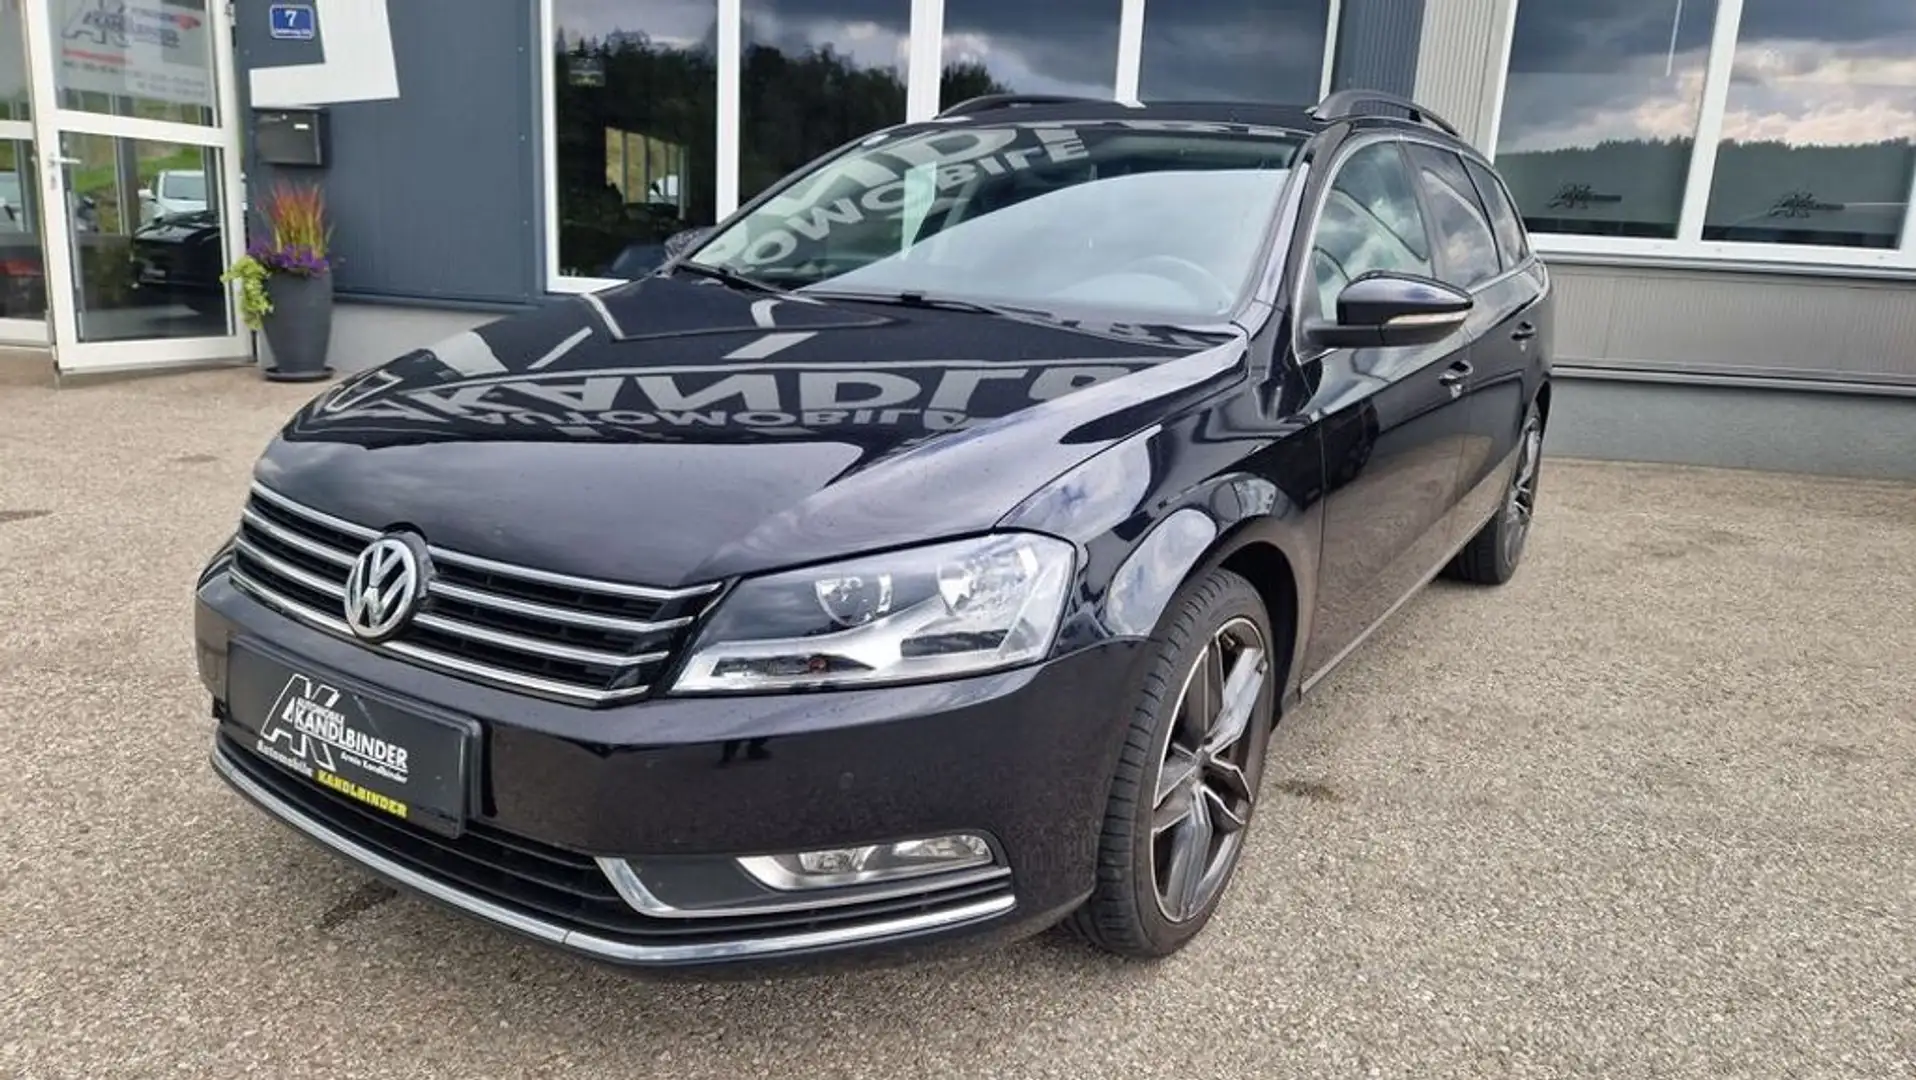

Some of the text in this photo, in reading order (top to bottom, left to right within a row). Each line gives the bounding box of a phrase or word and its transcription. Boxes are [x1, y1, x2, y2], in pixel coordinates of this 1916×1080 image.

[284, 10, 297, 27] 7
[295, 704, 408, 770] KANDLBINDER
[318, 769, 408, 819] KANDLBINDER
